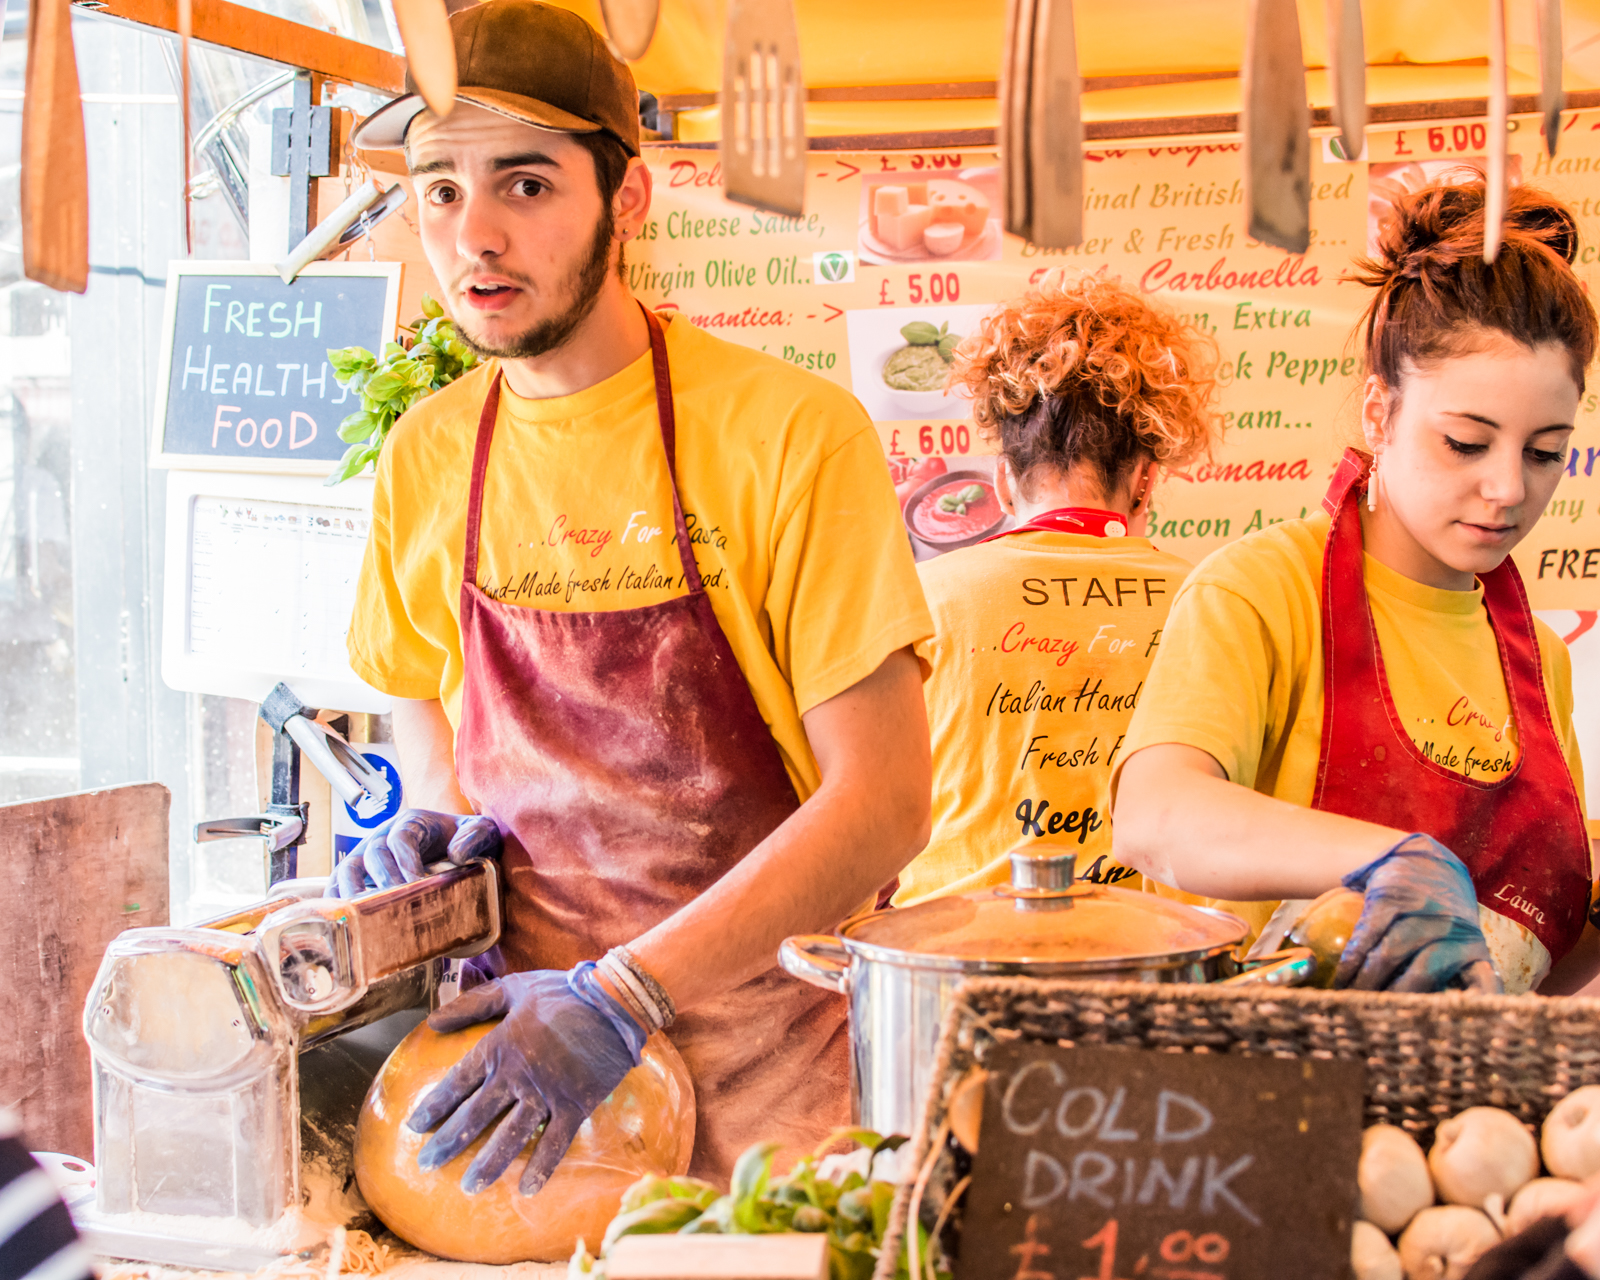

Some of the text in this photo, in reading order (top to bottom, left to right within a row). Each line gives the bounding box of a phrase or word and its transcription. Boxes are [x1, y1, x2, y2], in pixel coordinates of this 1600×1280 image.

[1428, 123, 1487, 153] 6.00
[1149, 180, 1244, 209] British
[667, 209, 740, 240] Cheese
[1123, 227, 1144, 254] &
[1157, 223, 1234, 253] Fresh
[629, 261, 695, 298] Virgin
[705, 259, 756, 288] Olive
[879, 272, 961, 305] £ 5.00
[1140, 256, 1323, 294] Carbonella
[202, 284, 323, 339] FRESH
[1233, 301, 1312, 332] Extra
[211, 404, 318, 450] FOOD
[890, 424, 971, 456] £ 6.00
[620, 510, 663, 545] For
[565, 568, 612, 603] fresh
[616, 564, 673, 590] Italian
[1022, 577, 1166, 607] STAFF
[1087, 624, 1137, 655] For
[986, 679, 1067, 717] Italian
[1021, 734, 1099, 771] Fresh
[1464, 746, 1513, 777] fresh
[1015, 798, 1102, 845] Keep
[1493, 883, 1546, 925] Laura
[1001, 1059, 1215, 1144] COLD
[1022, 1149, 1263, 1227] DRINK
